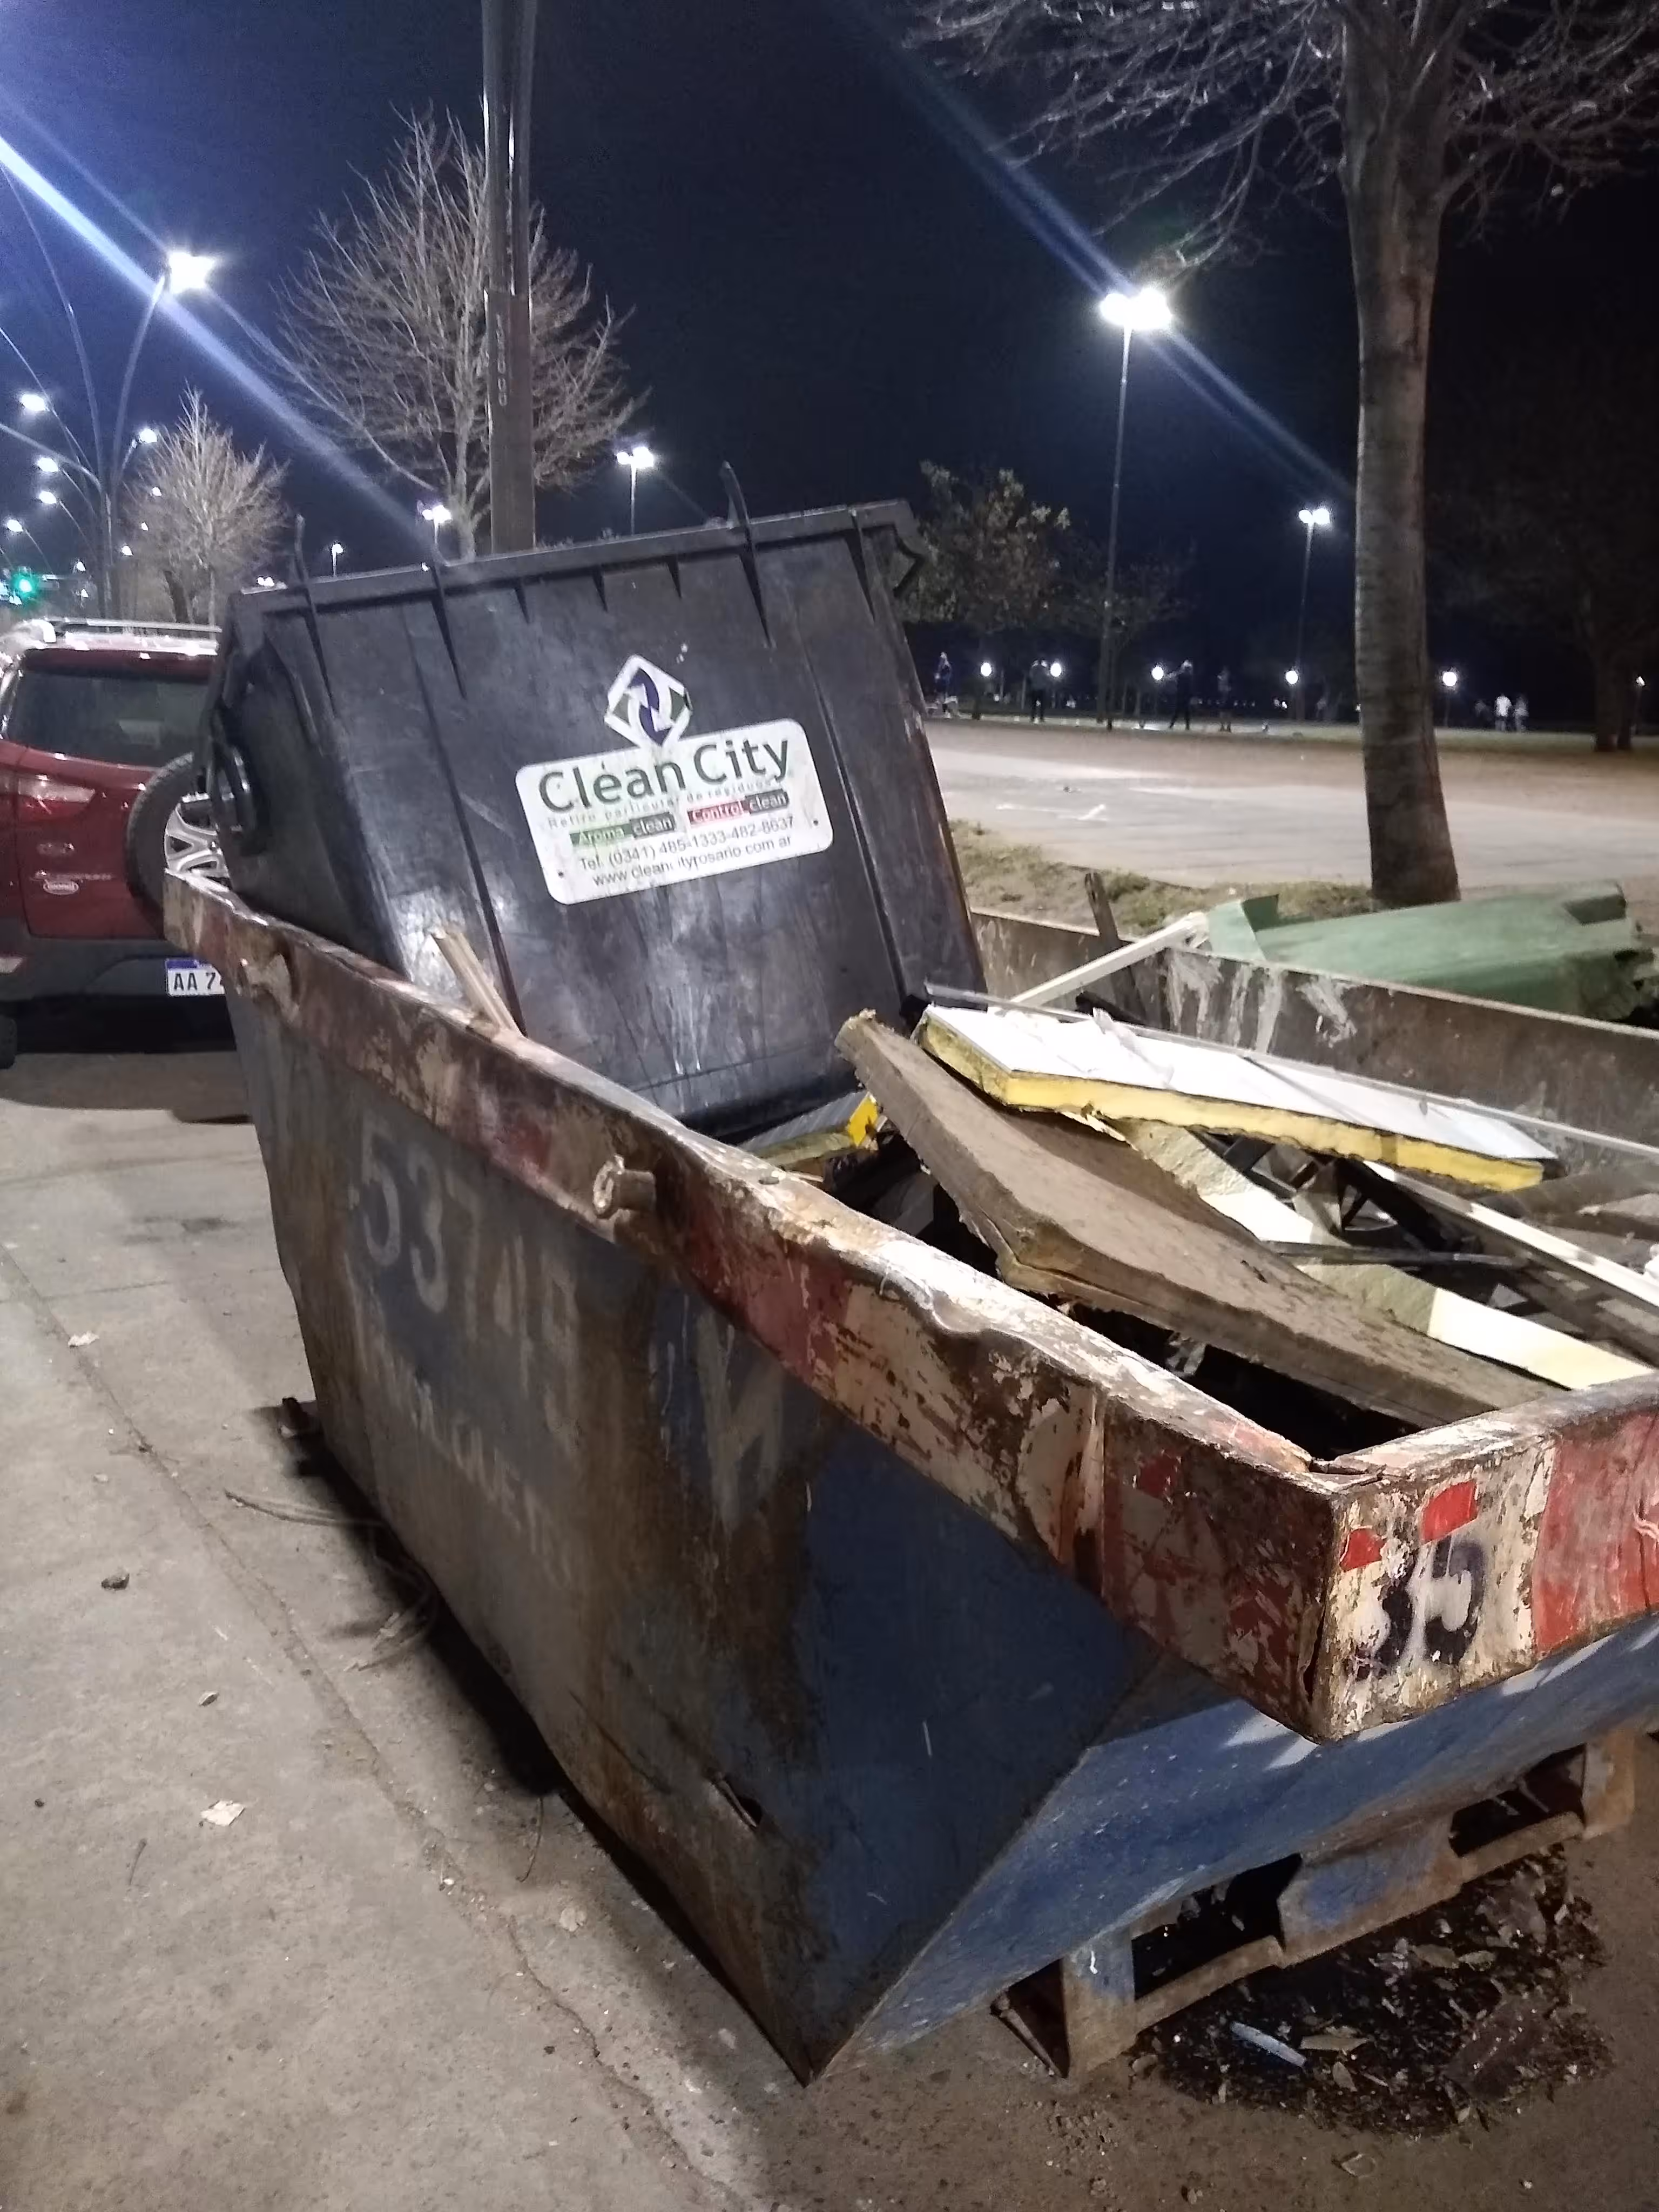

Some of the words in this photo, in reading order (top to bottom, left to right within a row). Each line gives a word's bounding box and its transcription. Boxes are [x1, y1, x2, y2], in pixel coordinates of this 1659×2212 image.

[539, 760, 686, 811] Clean
[693, 739, 788, 785] City
[692, 799, 744, 822] Control
[749, 793, 787, 812] clean
[579, 827, 625, 846] Aroma
[633, 817, 671, 835] clean
[609, 845, 656, 868] (0341)
[174, 973, 198, 990] AA
